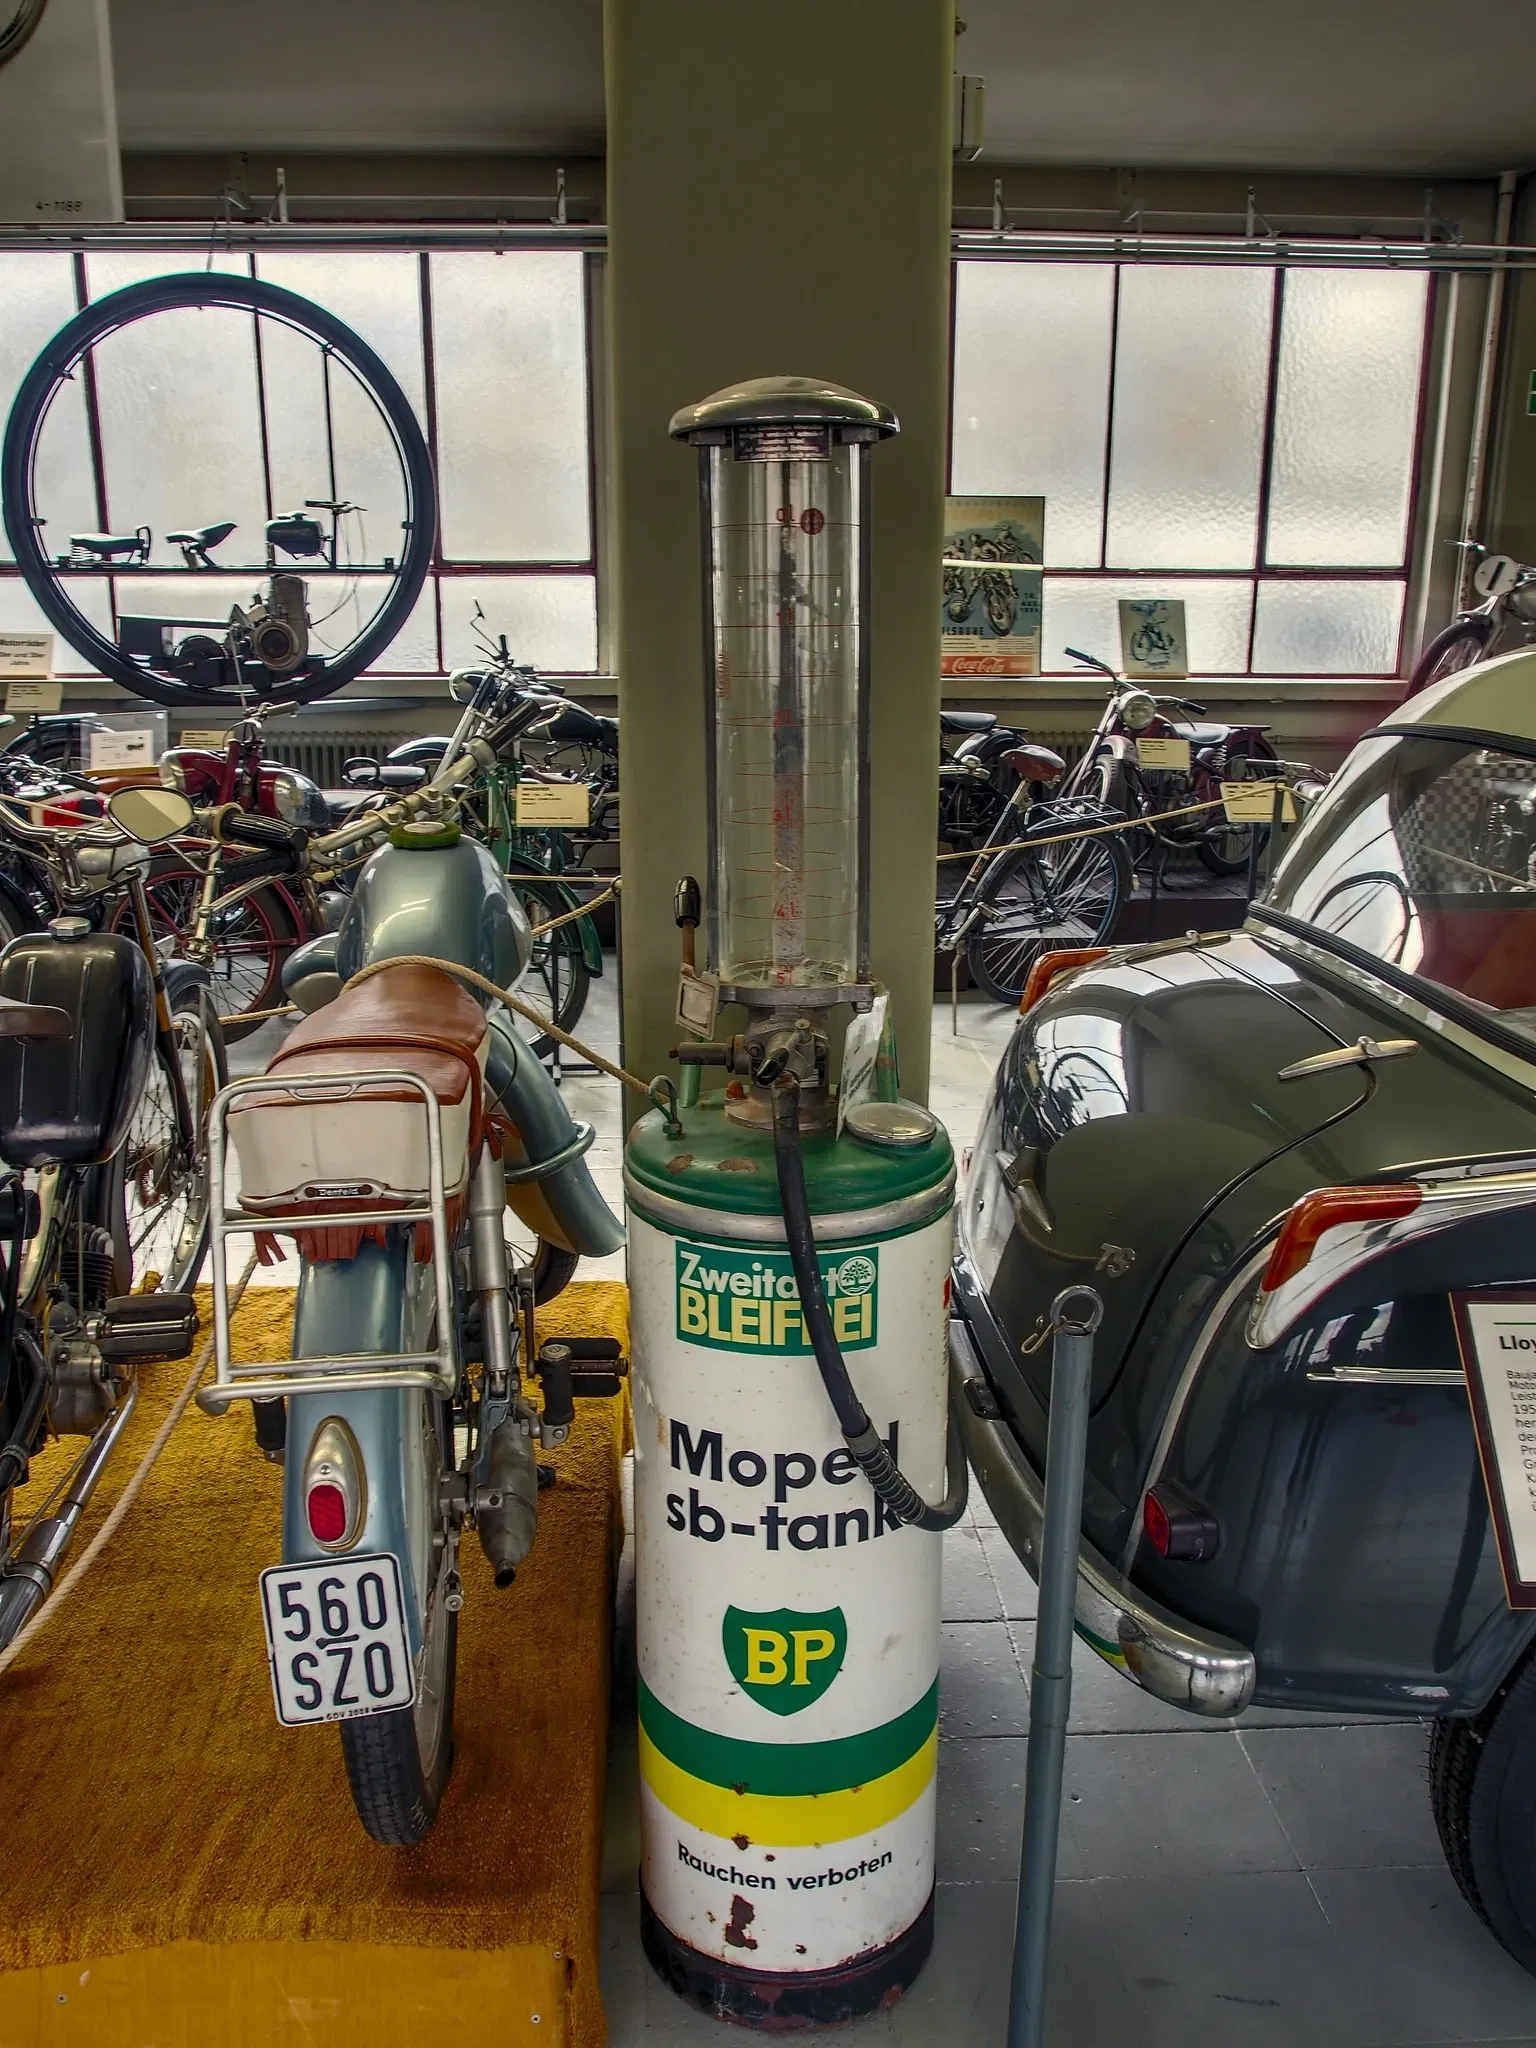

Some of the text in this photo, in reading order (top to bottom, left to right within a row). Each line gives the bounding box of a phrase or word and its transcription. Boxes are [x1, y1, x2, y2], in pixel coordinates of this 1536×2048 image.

[951, 656, 1005, 673] Coca-Cola
[318, 1187, 359, 1196] Denfeld
[680, 1251, 838, 1299] Zweitat
[1095, 1242, 1136, 1277] TS
[666, 1487, 904, 1551] sb-tank
[278, 1572, 388, 1642] 560
[291, 1642, 394, 1710] SZO
[741, 1628, 836, 1686] BP
[678, 1840, 892, 1890] Rauchen verboten
